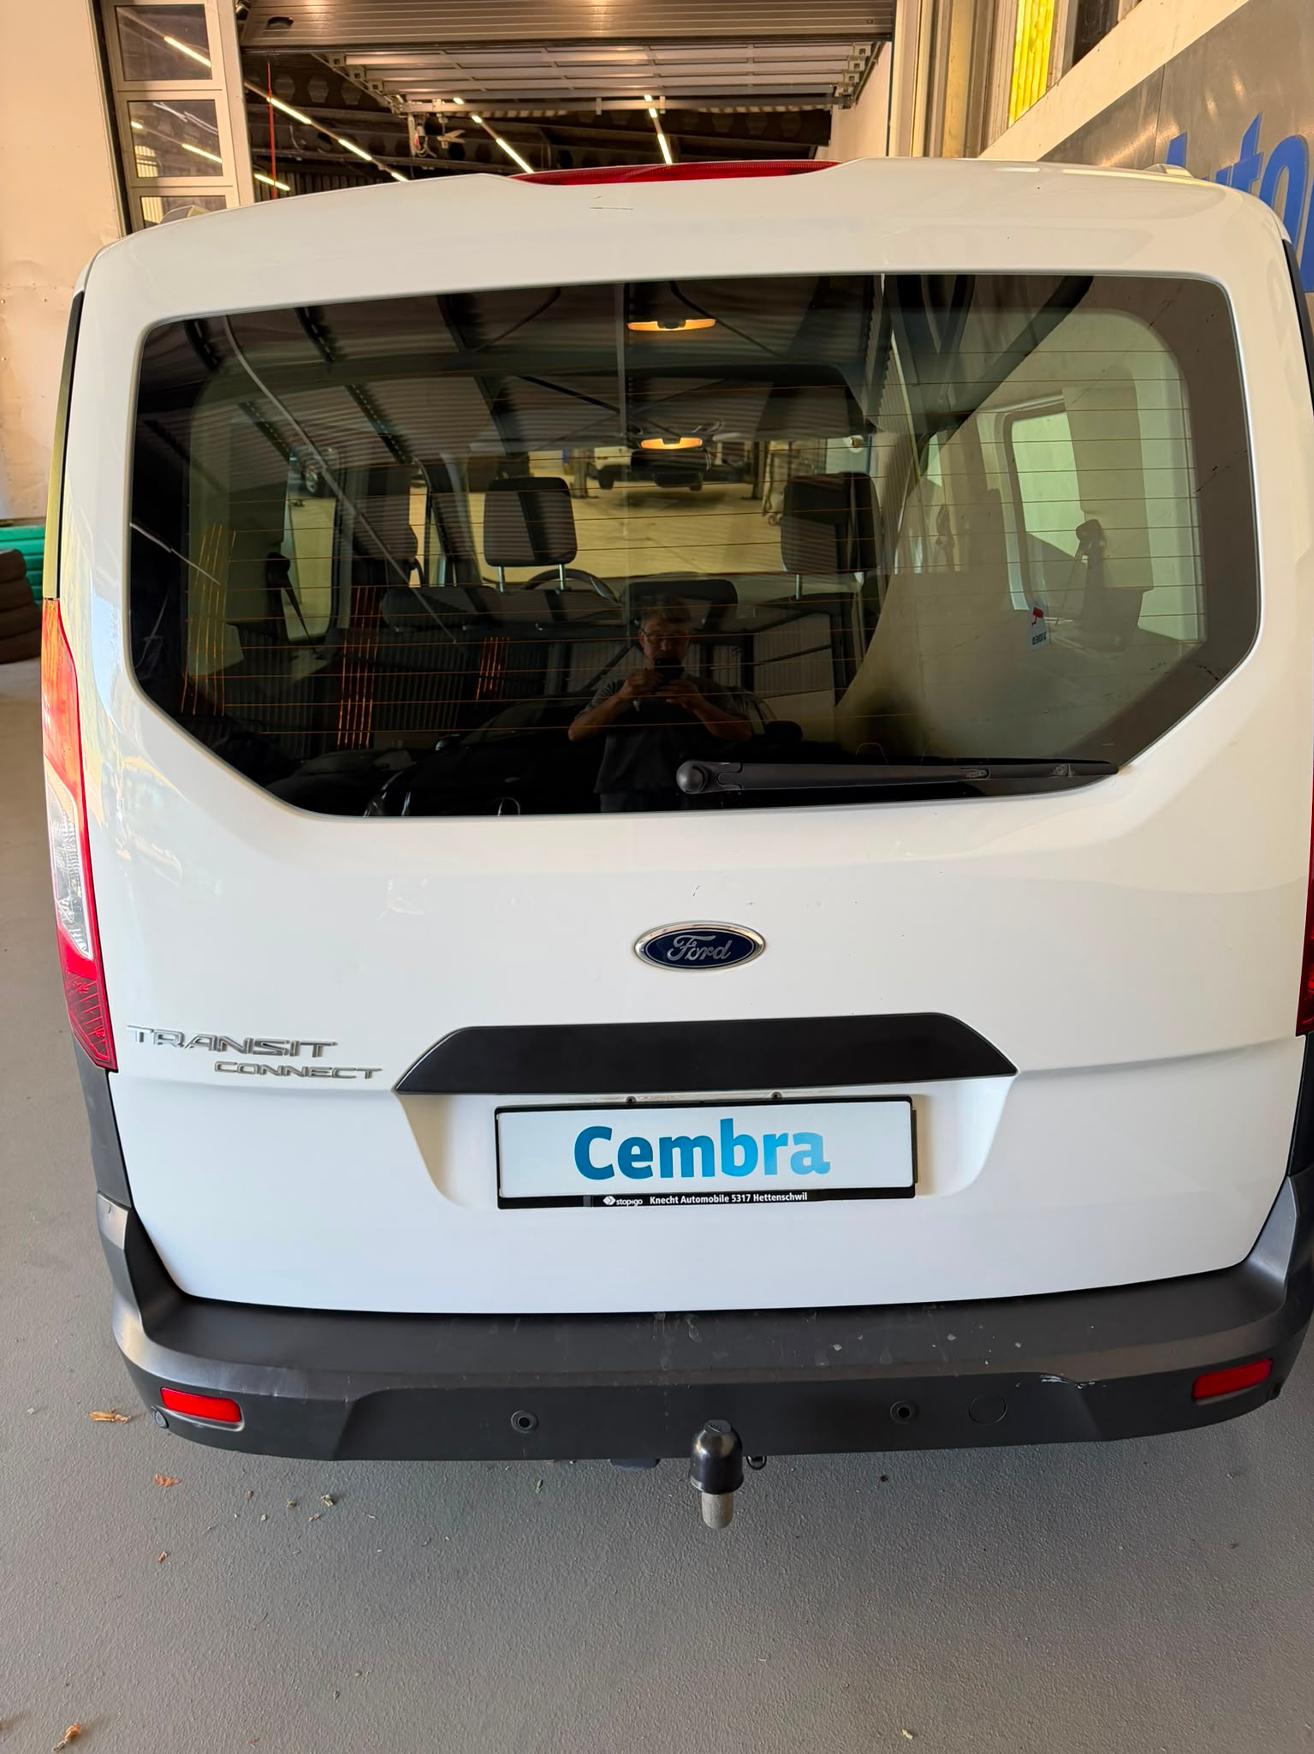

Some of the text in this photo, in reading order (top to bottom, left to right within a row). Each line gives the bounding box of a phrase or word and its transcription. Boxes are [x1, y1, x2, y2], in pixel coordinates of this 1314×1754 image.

[667, 934, 732, 960] Ford
[126, 1025, 338, 1058] TRANSIT
[214, 1060, 383, 1079] CONNECT
[574, 1117, 831, 1180] Cembra
[649, 1192, 808, 1204] Knecht Automobile 5317 Hettenschwil
